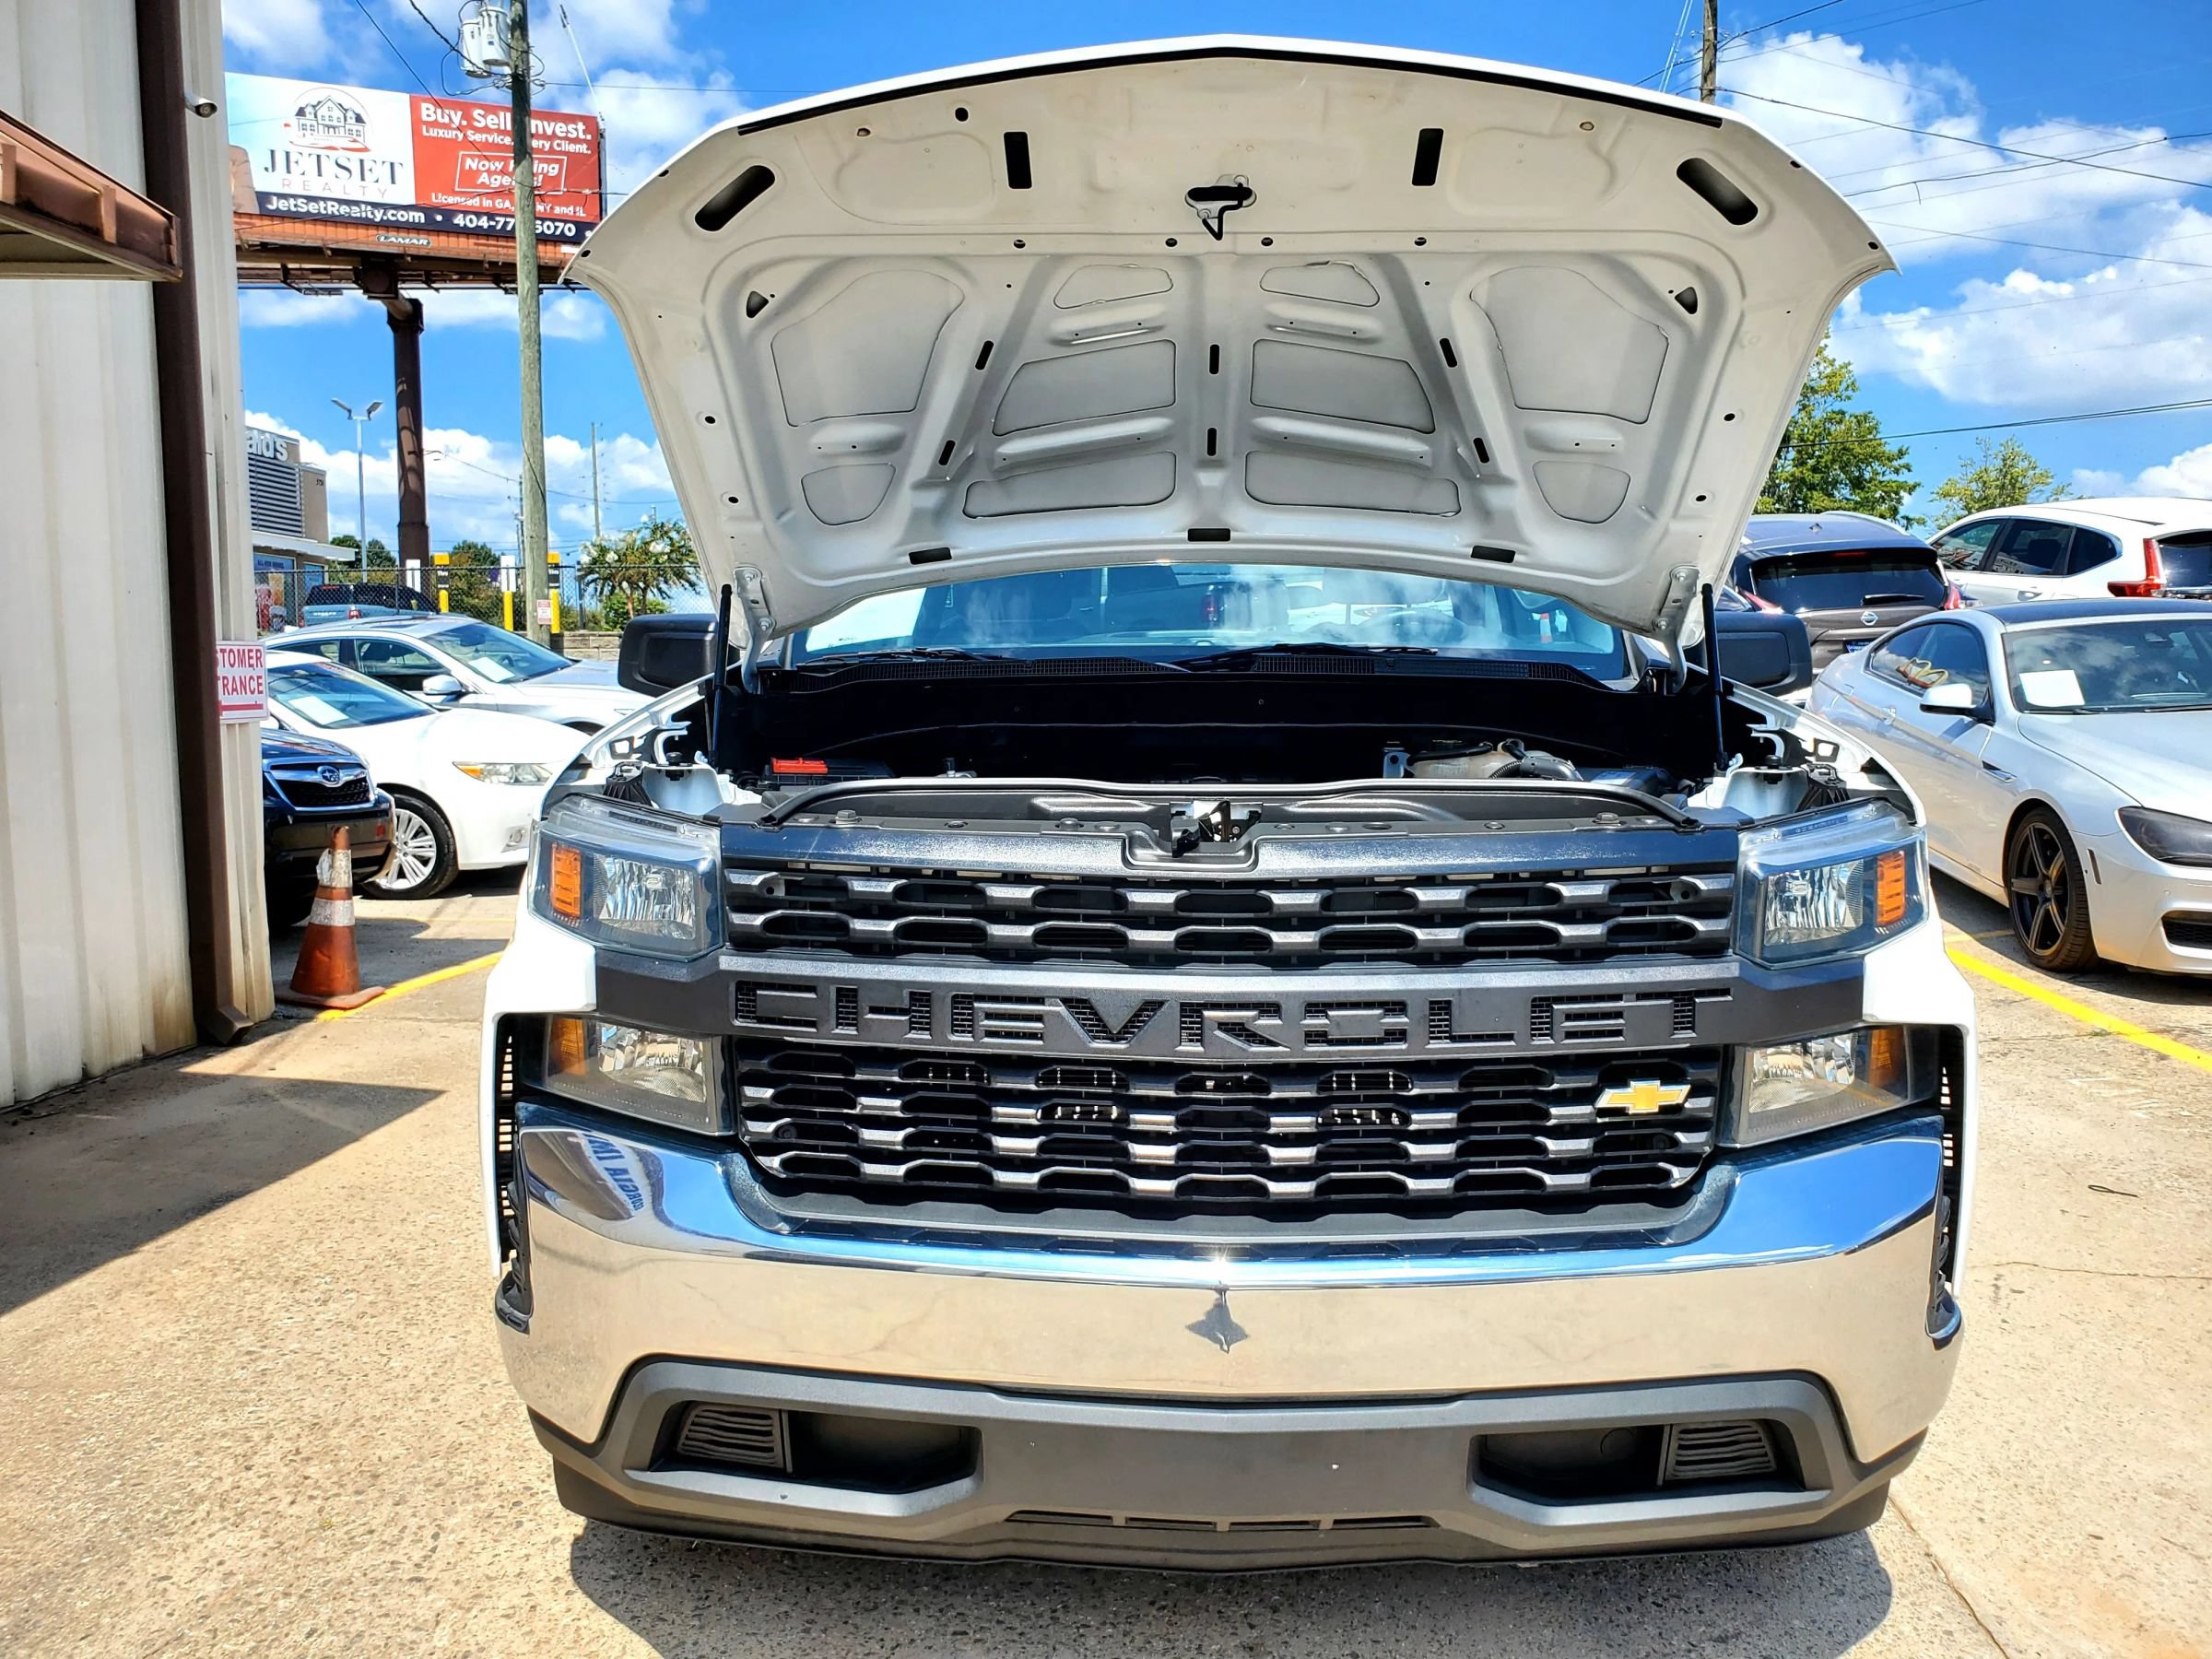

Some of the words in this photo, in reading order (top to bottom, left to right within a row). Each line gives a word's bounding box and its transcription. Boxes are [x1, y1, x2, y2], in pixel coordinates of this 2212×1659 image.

[420, 102, 467, 127] Buy.
[472, 109, 512, 131] Sell
[530, 119, 592, 140] nvest.
[422, 124, 464, 141] Luxury
[466, 129, 514, 146] Service.
[532, 140, 551, 151] ery
[553, 140, 592, 154] Client.
[264, 149, 404, 184] JETSET
[465, 158, 504, 171] Now
[509, 159, 559, 176] ing
[281, 178, 388, 198] REALTY
[477, 172, 544, 187] Age!
[266, 195, 426, 223] JetSetRealty.com
[453, 213, 576, 237] 404-776070
[431, 193, 480, 206] Licensed
[495, 198, 514, 211] GA,
[553, 204, 574, 216] and
[378, 235, 429, 246] LAMAR
[247, 429, 288, 461] ald's
[217, 647, 264, 669] TOMER
[216, 675, 264, 696] RANCE
[734, 980, 1734, 1051] CHEVROLET
